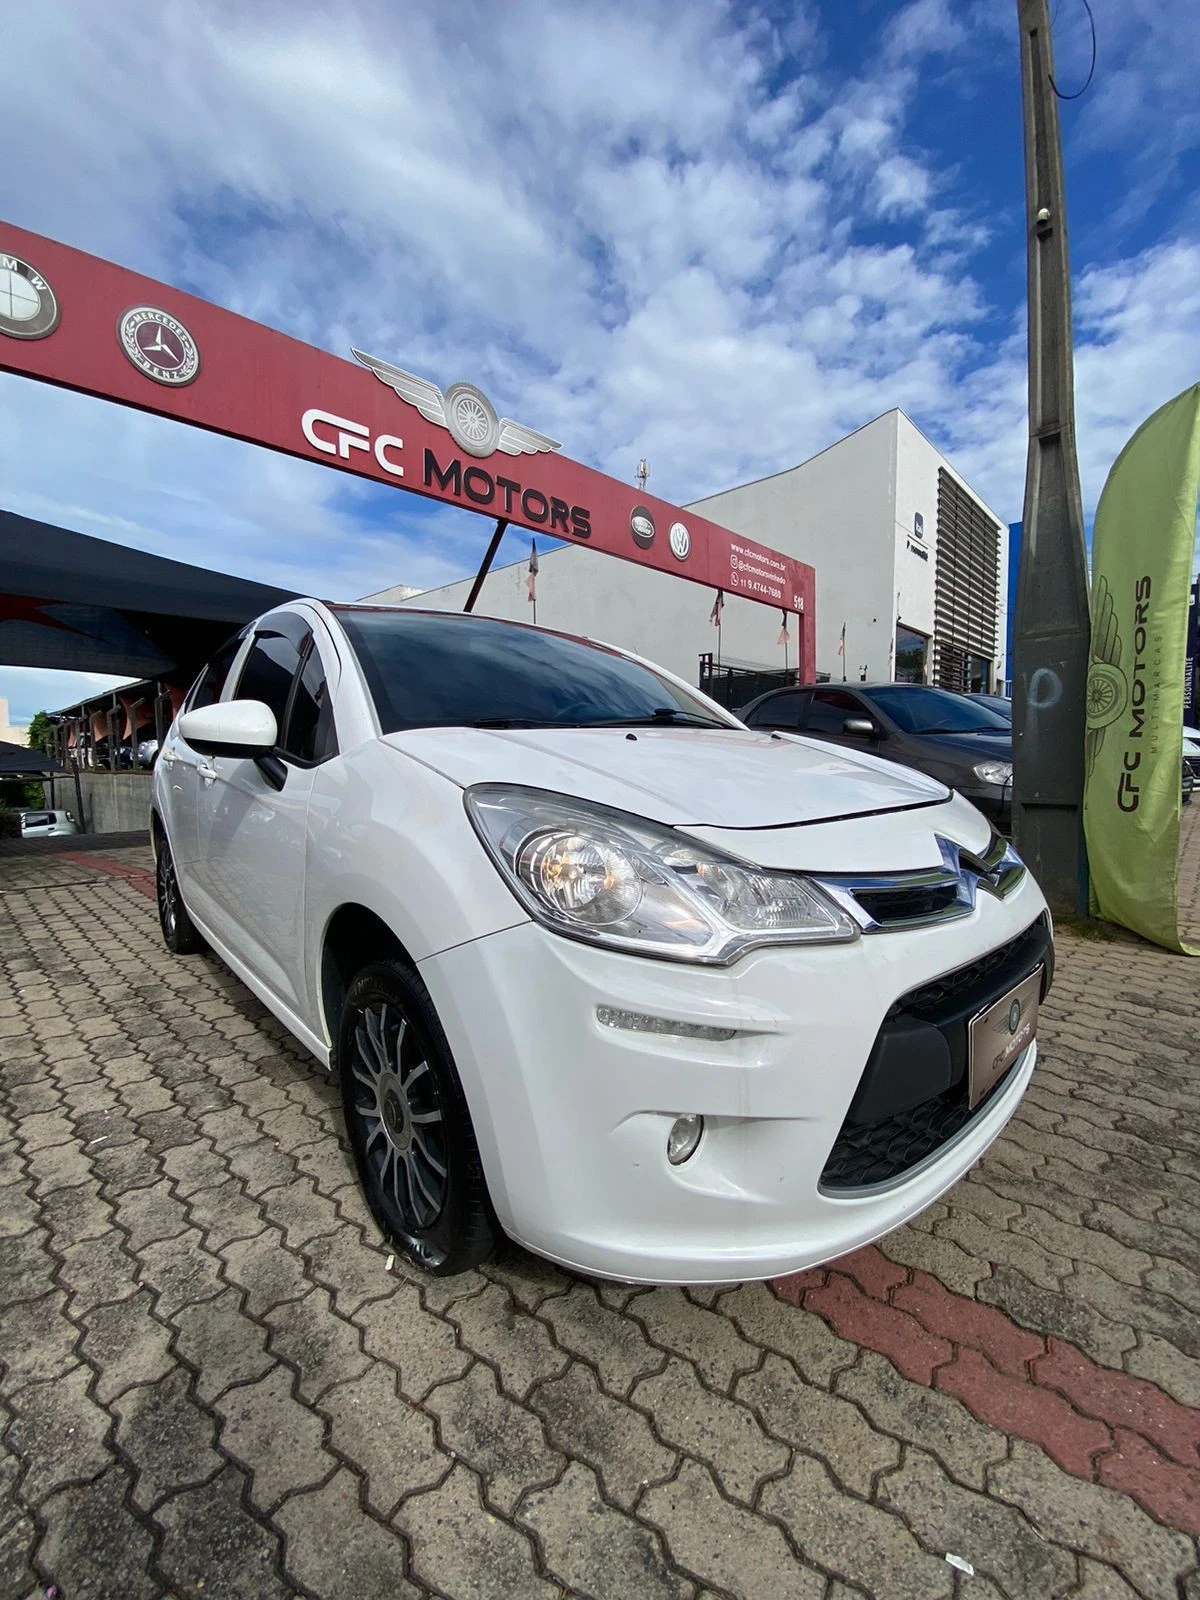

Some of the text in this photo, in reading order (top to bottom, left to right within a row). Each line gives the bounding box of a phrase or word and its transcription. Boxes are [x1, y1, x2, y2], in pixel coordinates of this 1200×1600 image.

[0, 257, 47, 291] MW
[133, 312, 188, 342] MERCEDES
[143, 361, 180, 379] BENZ
[302, 408, 592, 539] CFC MOTORS
[730, 543, 786, 571] www.cfcmotors.com.br
[1117, 576, 1151, 812] CFC MOTORS
[1150, 635, 1162, 754] MULTIMARCAS
